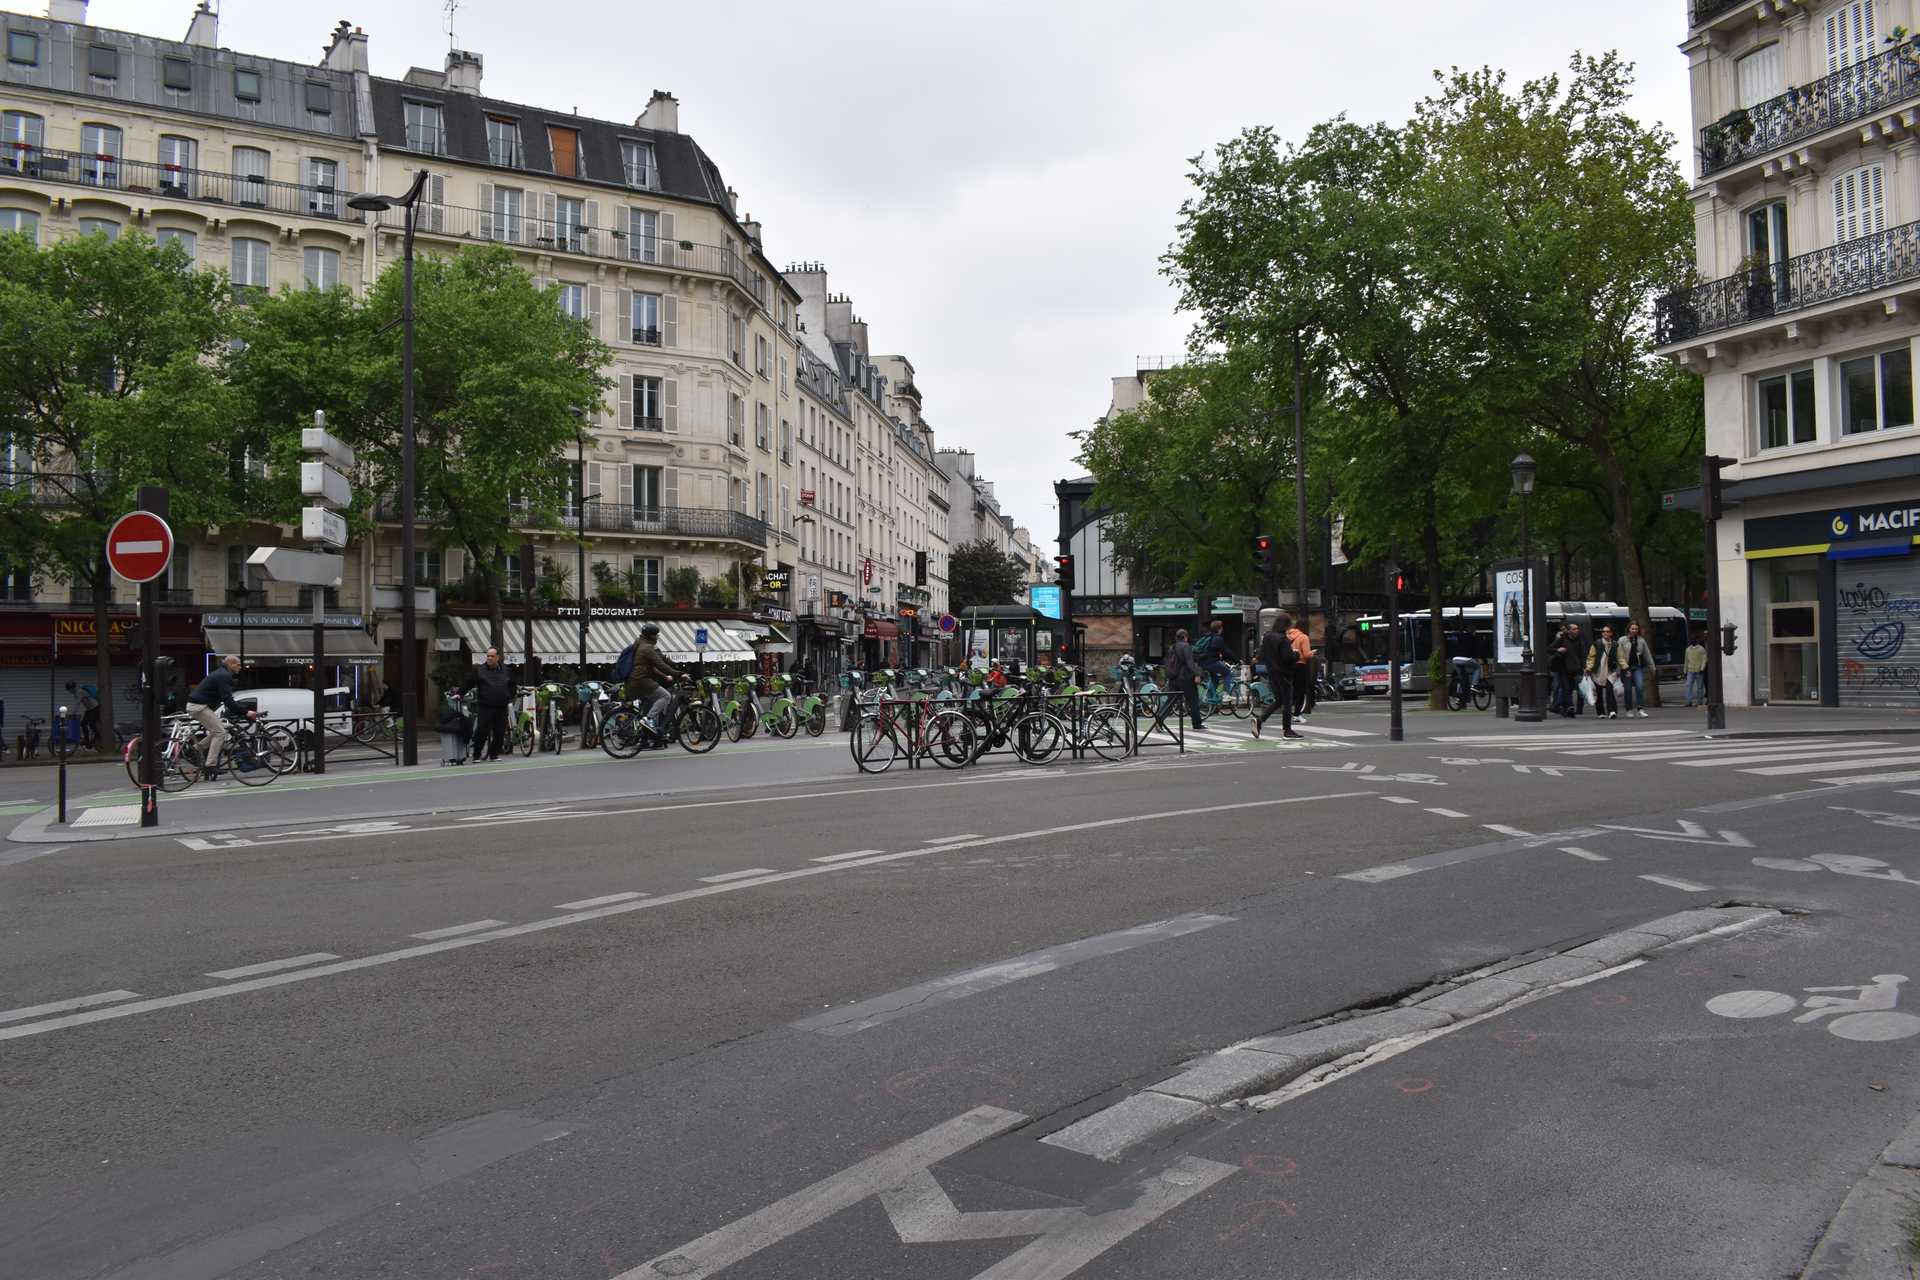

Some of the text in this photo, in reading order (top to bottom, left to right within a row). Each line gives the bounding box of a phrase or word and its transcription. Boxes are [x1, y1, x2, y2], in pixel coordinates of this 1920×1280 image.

[1859, 508, 1920, 532] MACIF
[769, 580, 781, 589] OR
[60, 620, 126, 634] NICOAS
